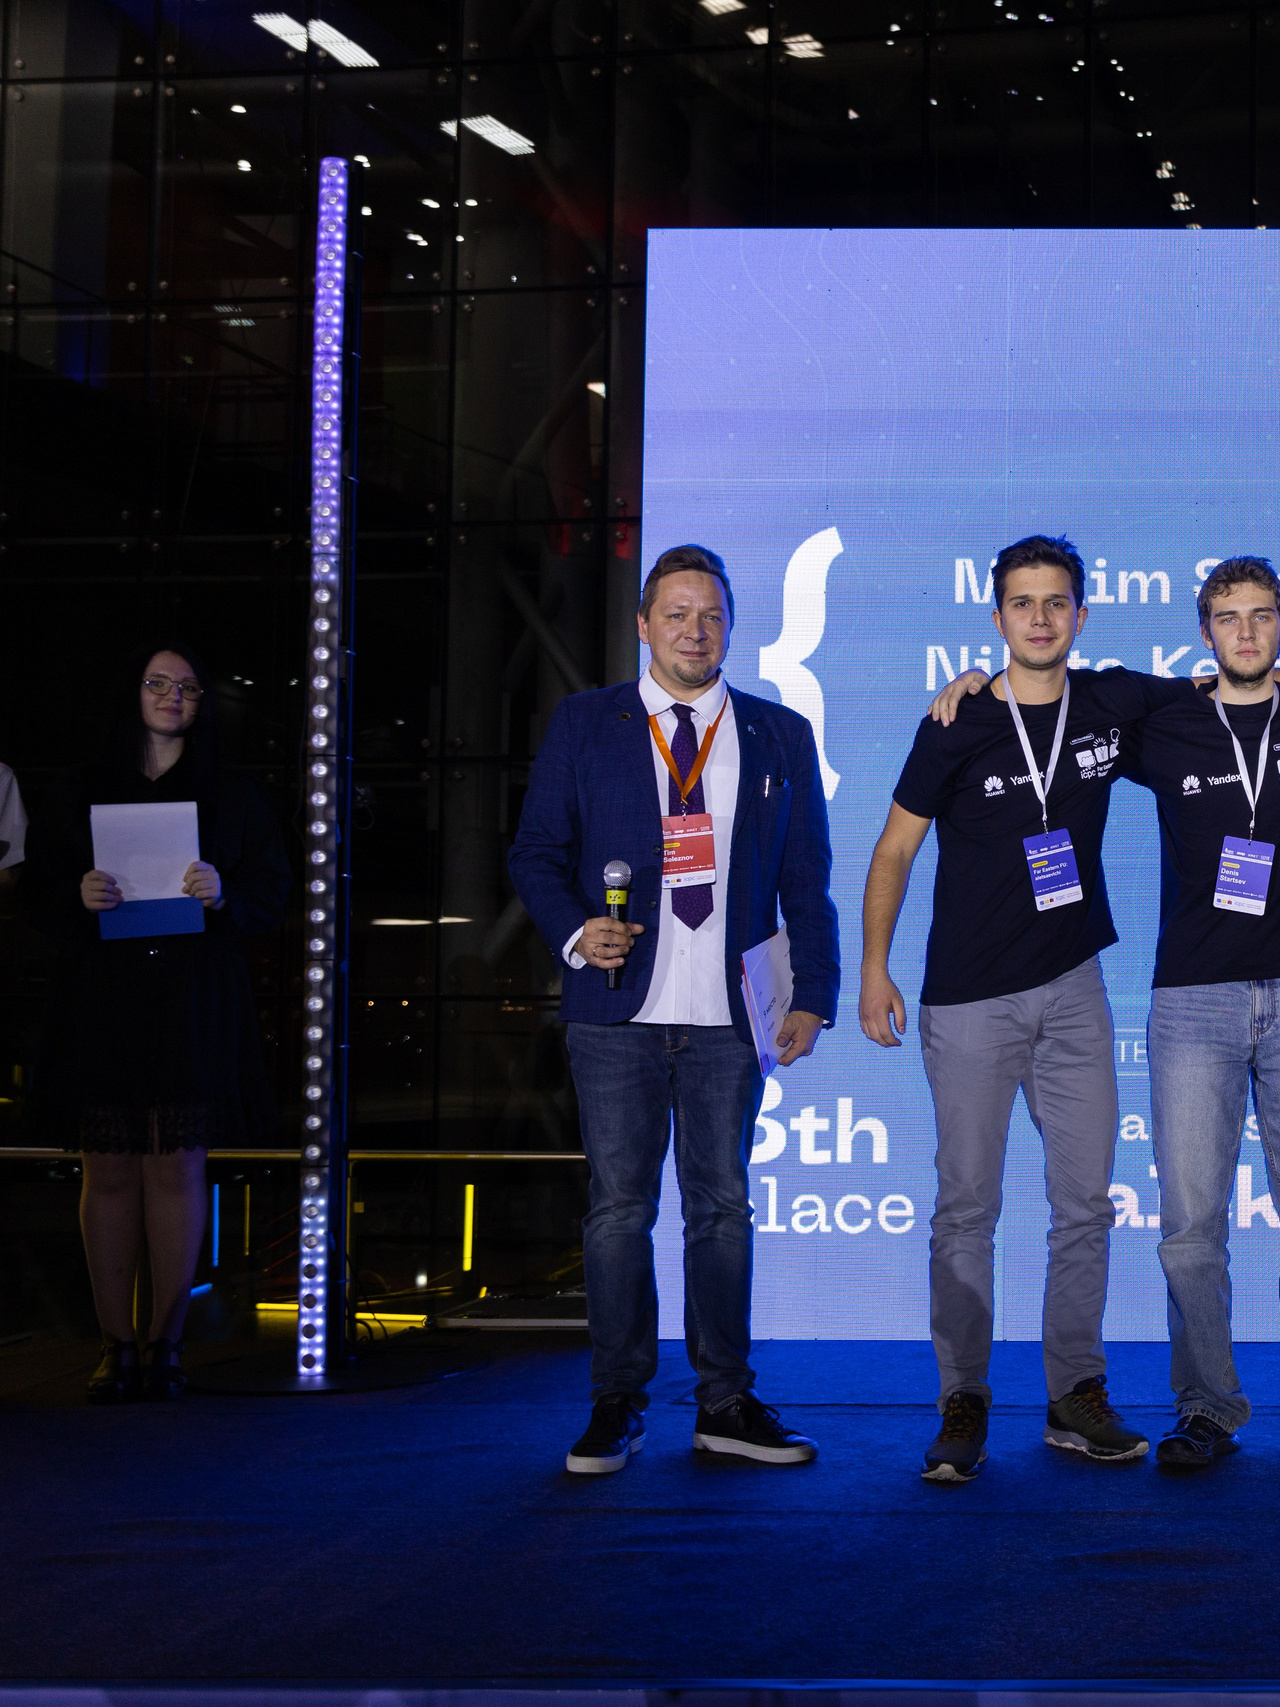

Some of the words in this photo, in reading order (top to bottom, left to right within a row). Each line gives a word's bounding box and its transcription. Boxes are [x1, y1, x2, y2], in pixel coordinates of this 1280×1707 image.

[955, 557, 1171, 604] Mim
[1080, 768, 1096, 780] icpc
[1207, 773, 1242, 786] Yandex
[985, 789, 1005, 797] HUAWEI
[1042, 865, 1060, 873] Eastern
[1220, 868, 1239, 877] Denis
[1219, 875, 1247, 885] Startsev
[749, 1177, 915, 1234] lace
